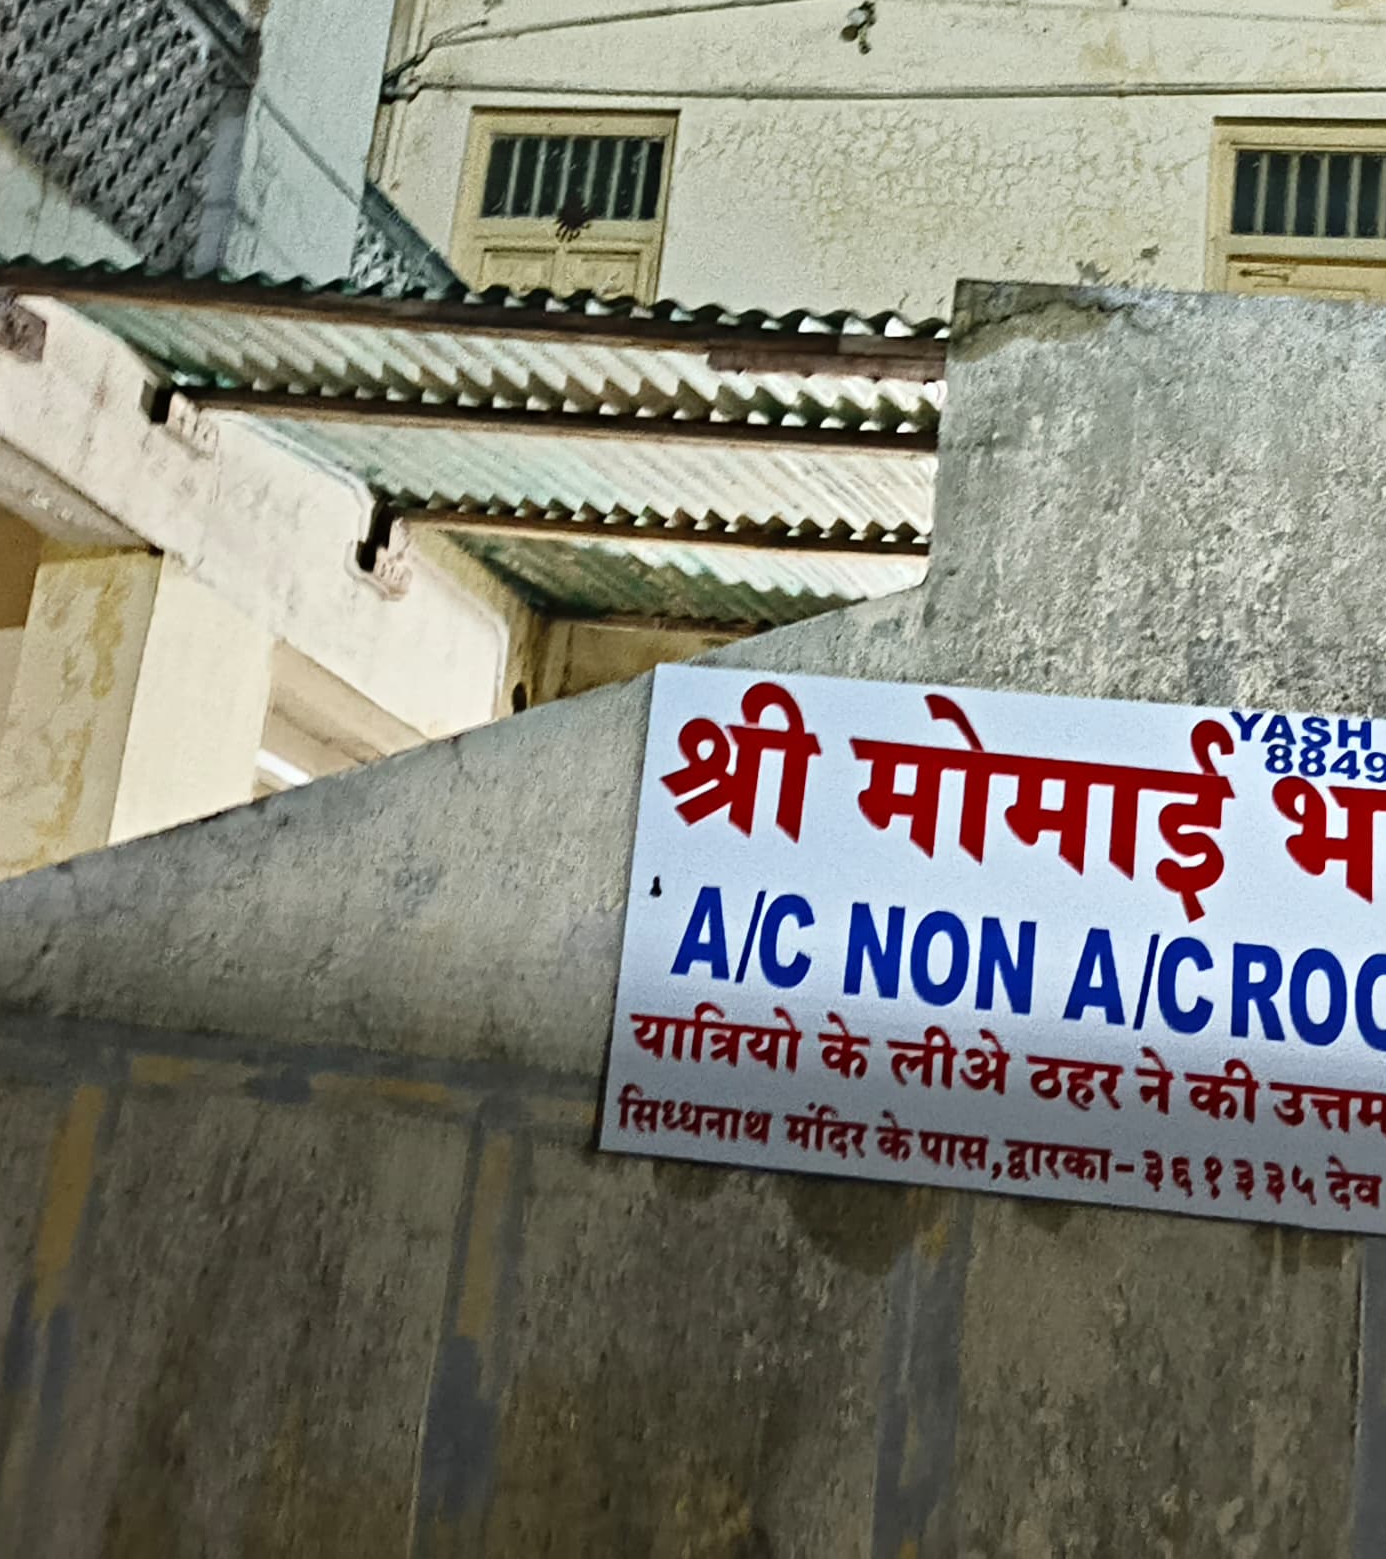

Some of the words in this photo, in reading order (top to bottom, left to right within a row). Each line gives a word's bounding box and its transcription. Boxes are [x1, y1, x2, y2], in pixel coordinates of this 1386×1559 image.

[1230, 711, 1373, 749] YASH
[661, 682, 822, 843] श्री
[850, 694, 1236, 923] मोमाई
[670, 886, 817, 989] A/C
[842, 902, 1038, 1016] NON
[1063, 927, 1215, 1036] A/C
[631, 1002, 803, 1073] यात्रियो
[818, 1013, 870, 1078] के
[1185, 1059, 1261, 1124] की
[784, 1101, 868, 1158] मंदिर
